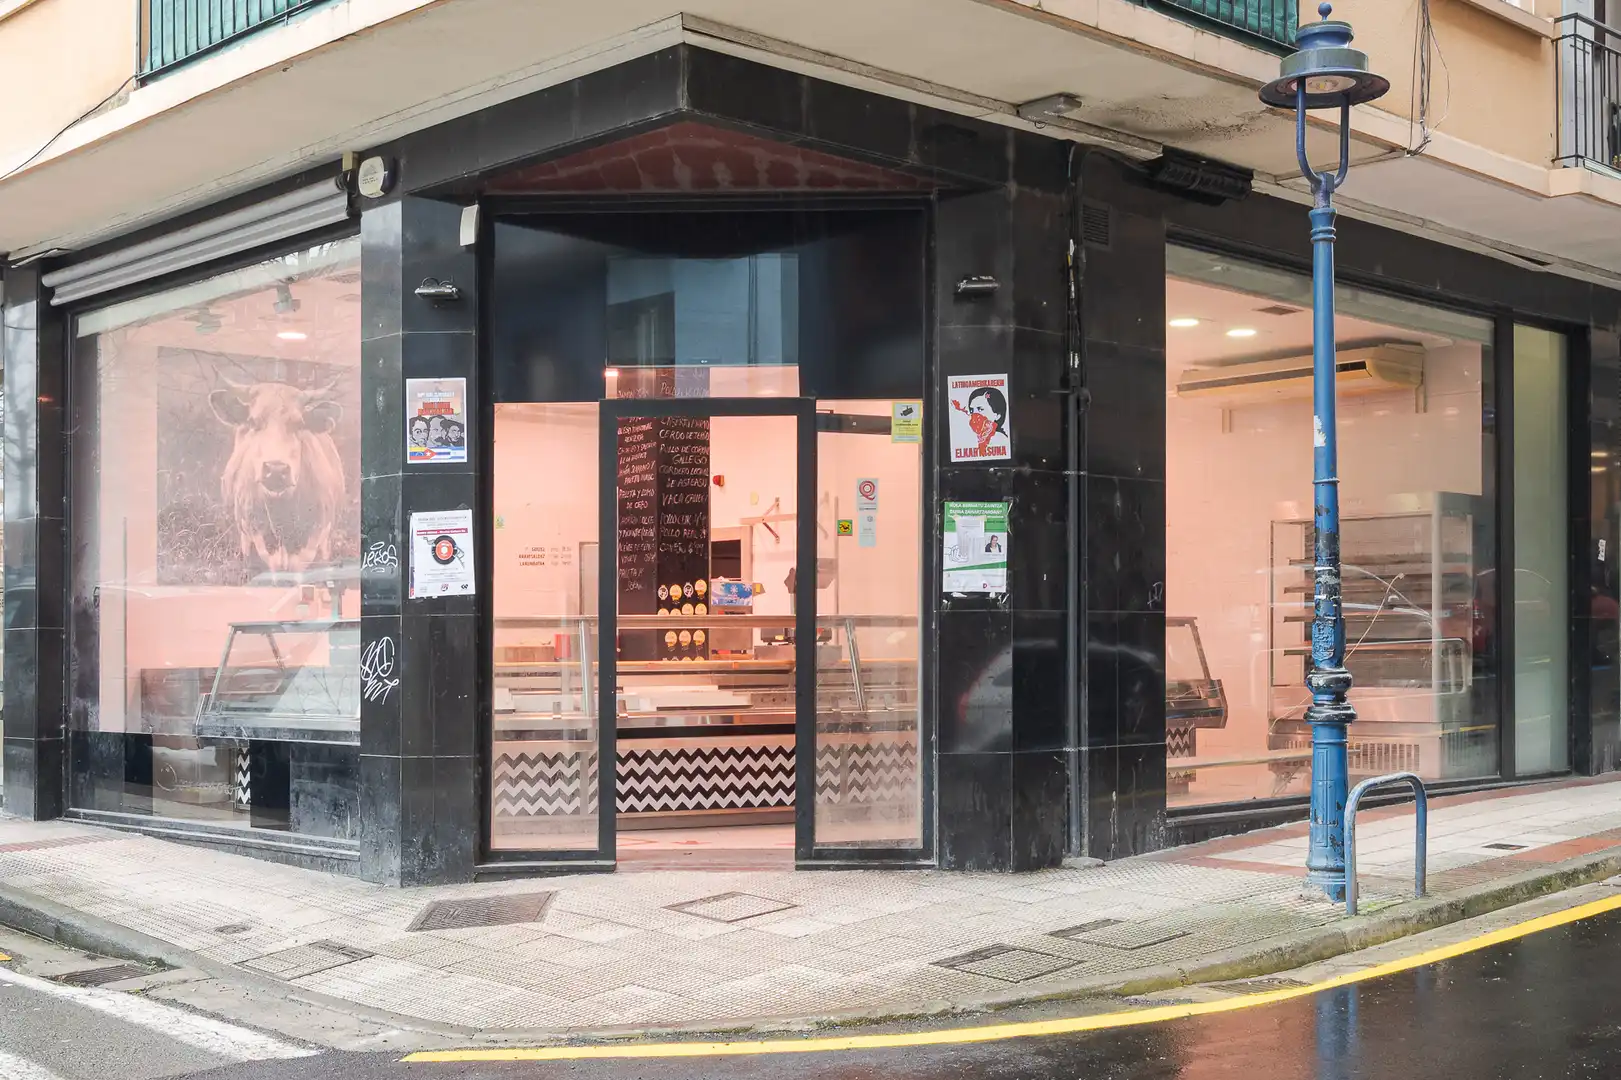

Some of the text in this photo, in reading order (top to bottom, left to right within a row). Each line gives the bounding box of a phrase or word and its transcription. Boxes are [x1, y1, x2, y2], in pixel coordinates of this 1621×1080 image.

[955, 446, 1006, 458] ELKARSUNA
[672, 454, 708, 465] GALLEGO
[662, 493, 684, 506] VACA
